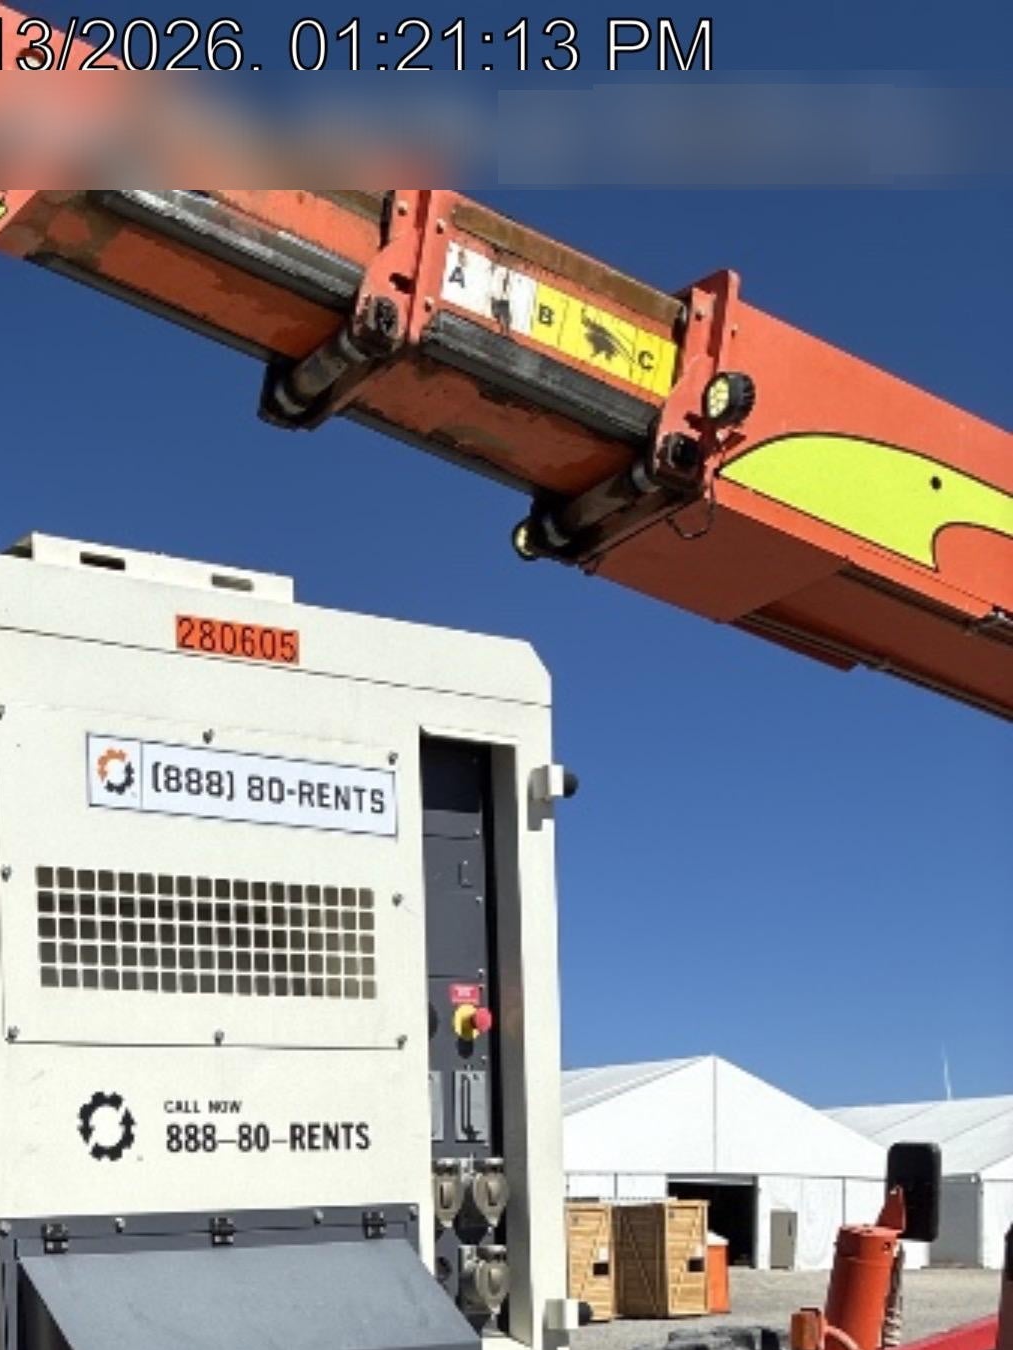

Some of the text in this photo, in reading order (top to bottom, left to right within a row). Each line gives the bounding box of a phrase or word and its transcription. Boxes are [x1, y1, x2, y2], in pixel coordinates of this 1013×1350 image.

[448, 266, 466, 288] A
[538, 305, 554, 326] B
[638, 350, 654, 370] C
[177, 616, 299, 664] 280605
[152, 761, 386, 814] (888) 80-RENTS
[164, 1100, 242, 1114] CALL NOW
[166, 1122, 371, 1152] 888-80-RENTS
